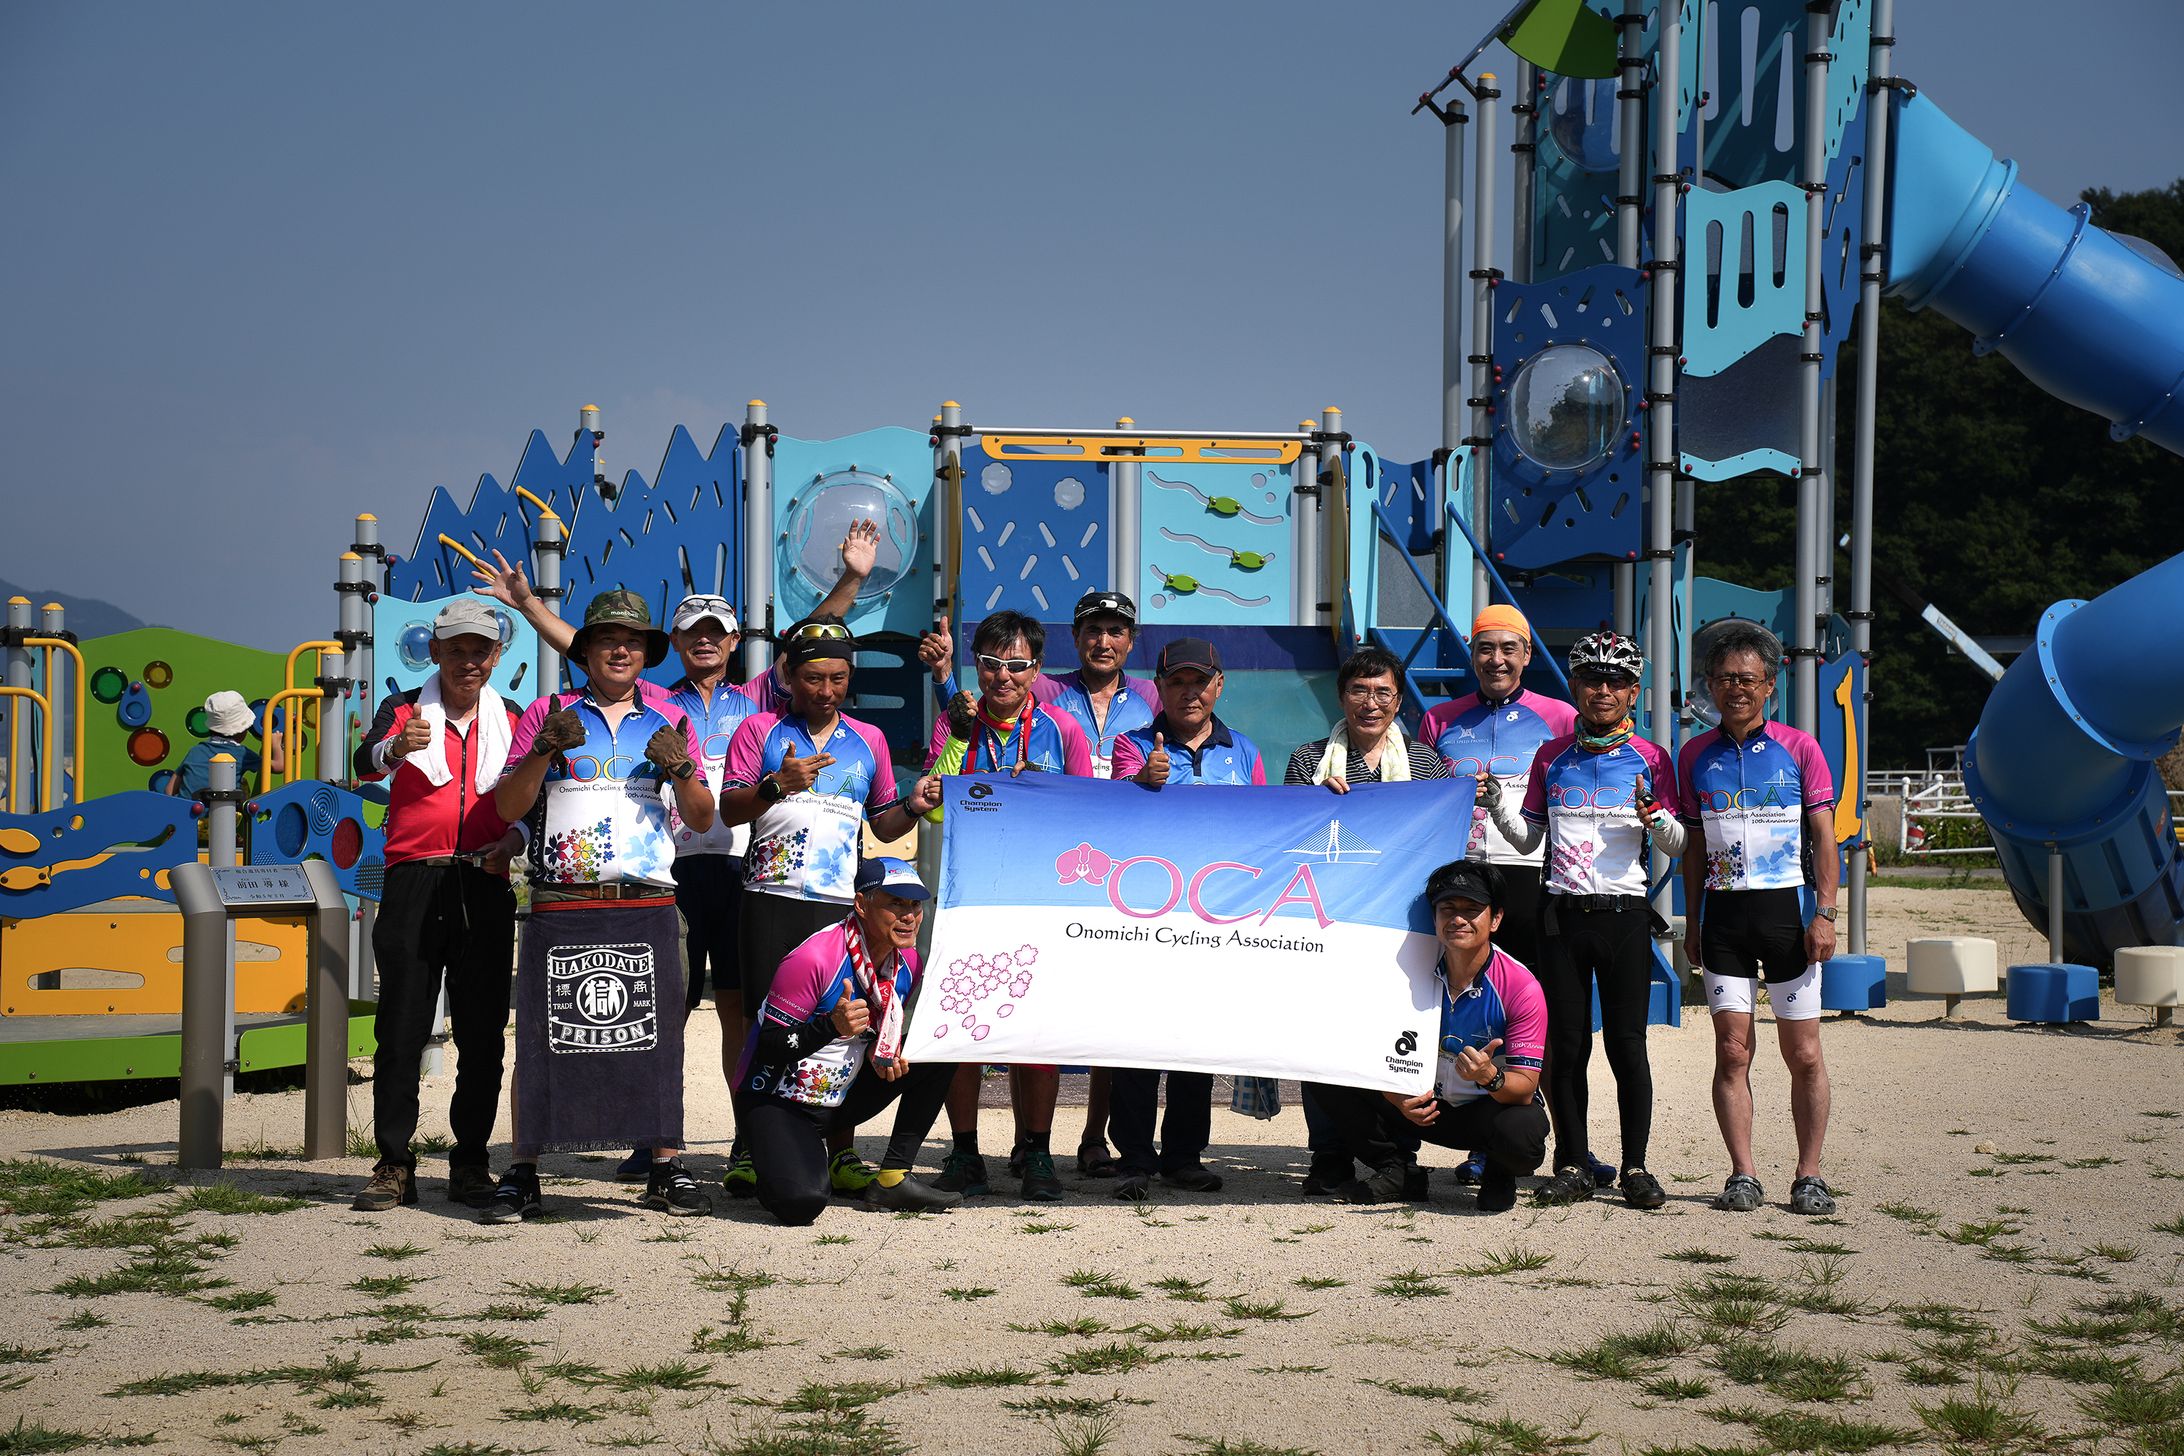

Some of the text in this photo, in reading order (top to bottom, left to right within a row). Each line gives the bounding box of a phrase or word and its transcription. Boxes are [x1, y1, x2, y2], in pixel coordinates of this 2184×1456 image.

[559, 785, 591, 794] Onomichi
[960, 799, 1003, 807] Champion
[1709, 786, 1787, 813] OCA
[1107, 855, 1335, 930] OCA
[1065, 922, 1325, 953] Onomichi Cycling Association
[553, 953, 649, 976] HAKODATE
[555, 983, 572, 997] 標
[632, 980, 648, 995] 商
[552, 1002, 573, 1011] TRADE
[632, 999, 651, 1009] MARK
[560, 1022, 646, 1045] PRISON
[1385, 1055, 1424, 1068] Champion
[1388, 1063, 1420, 1075] System
